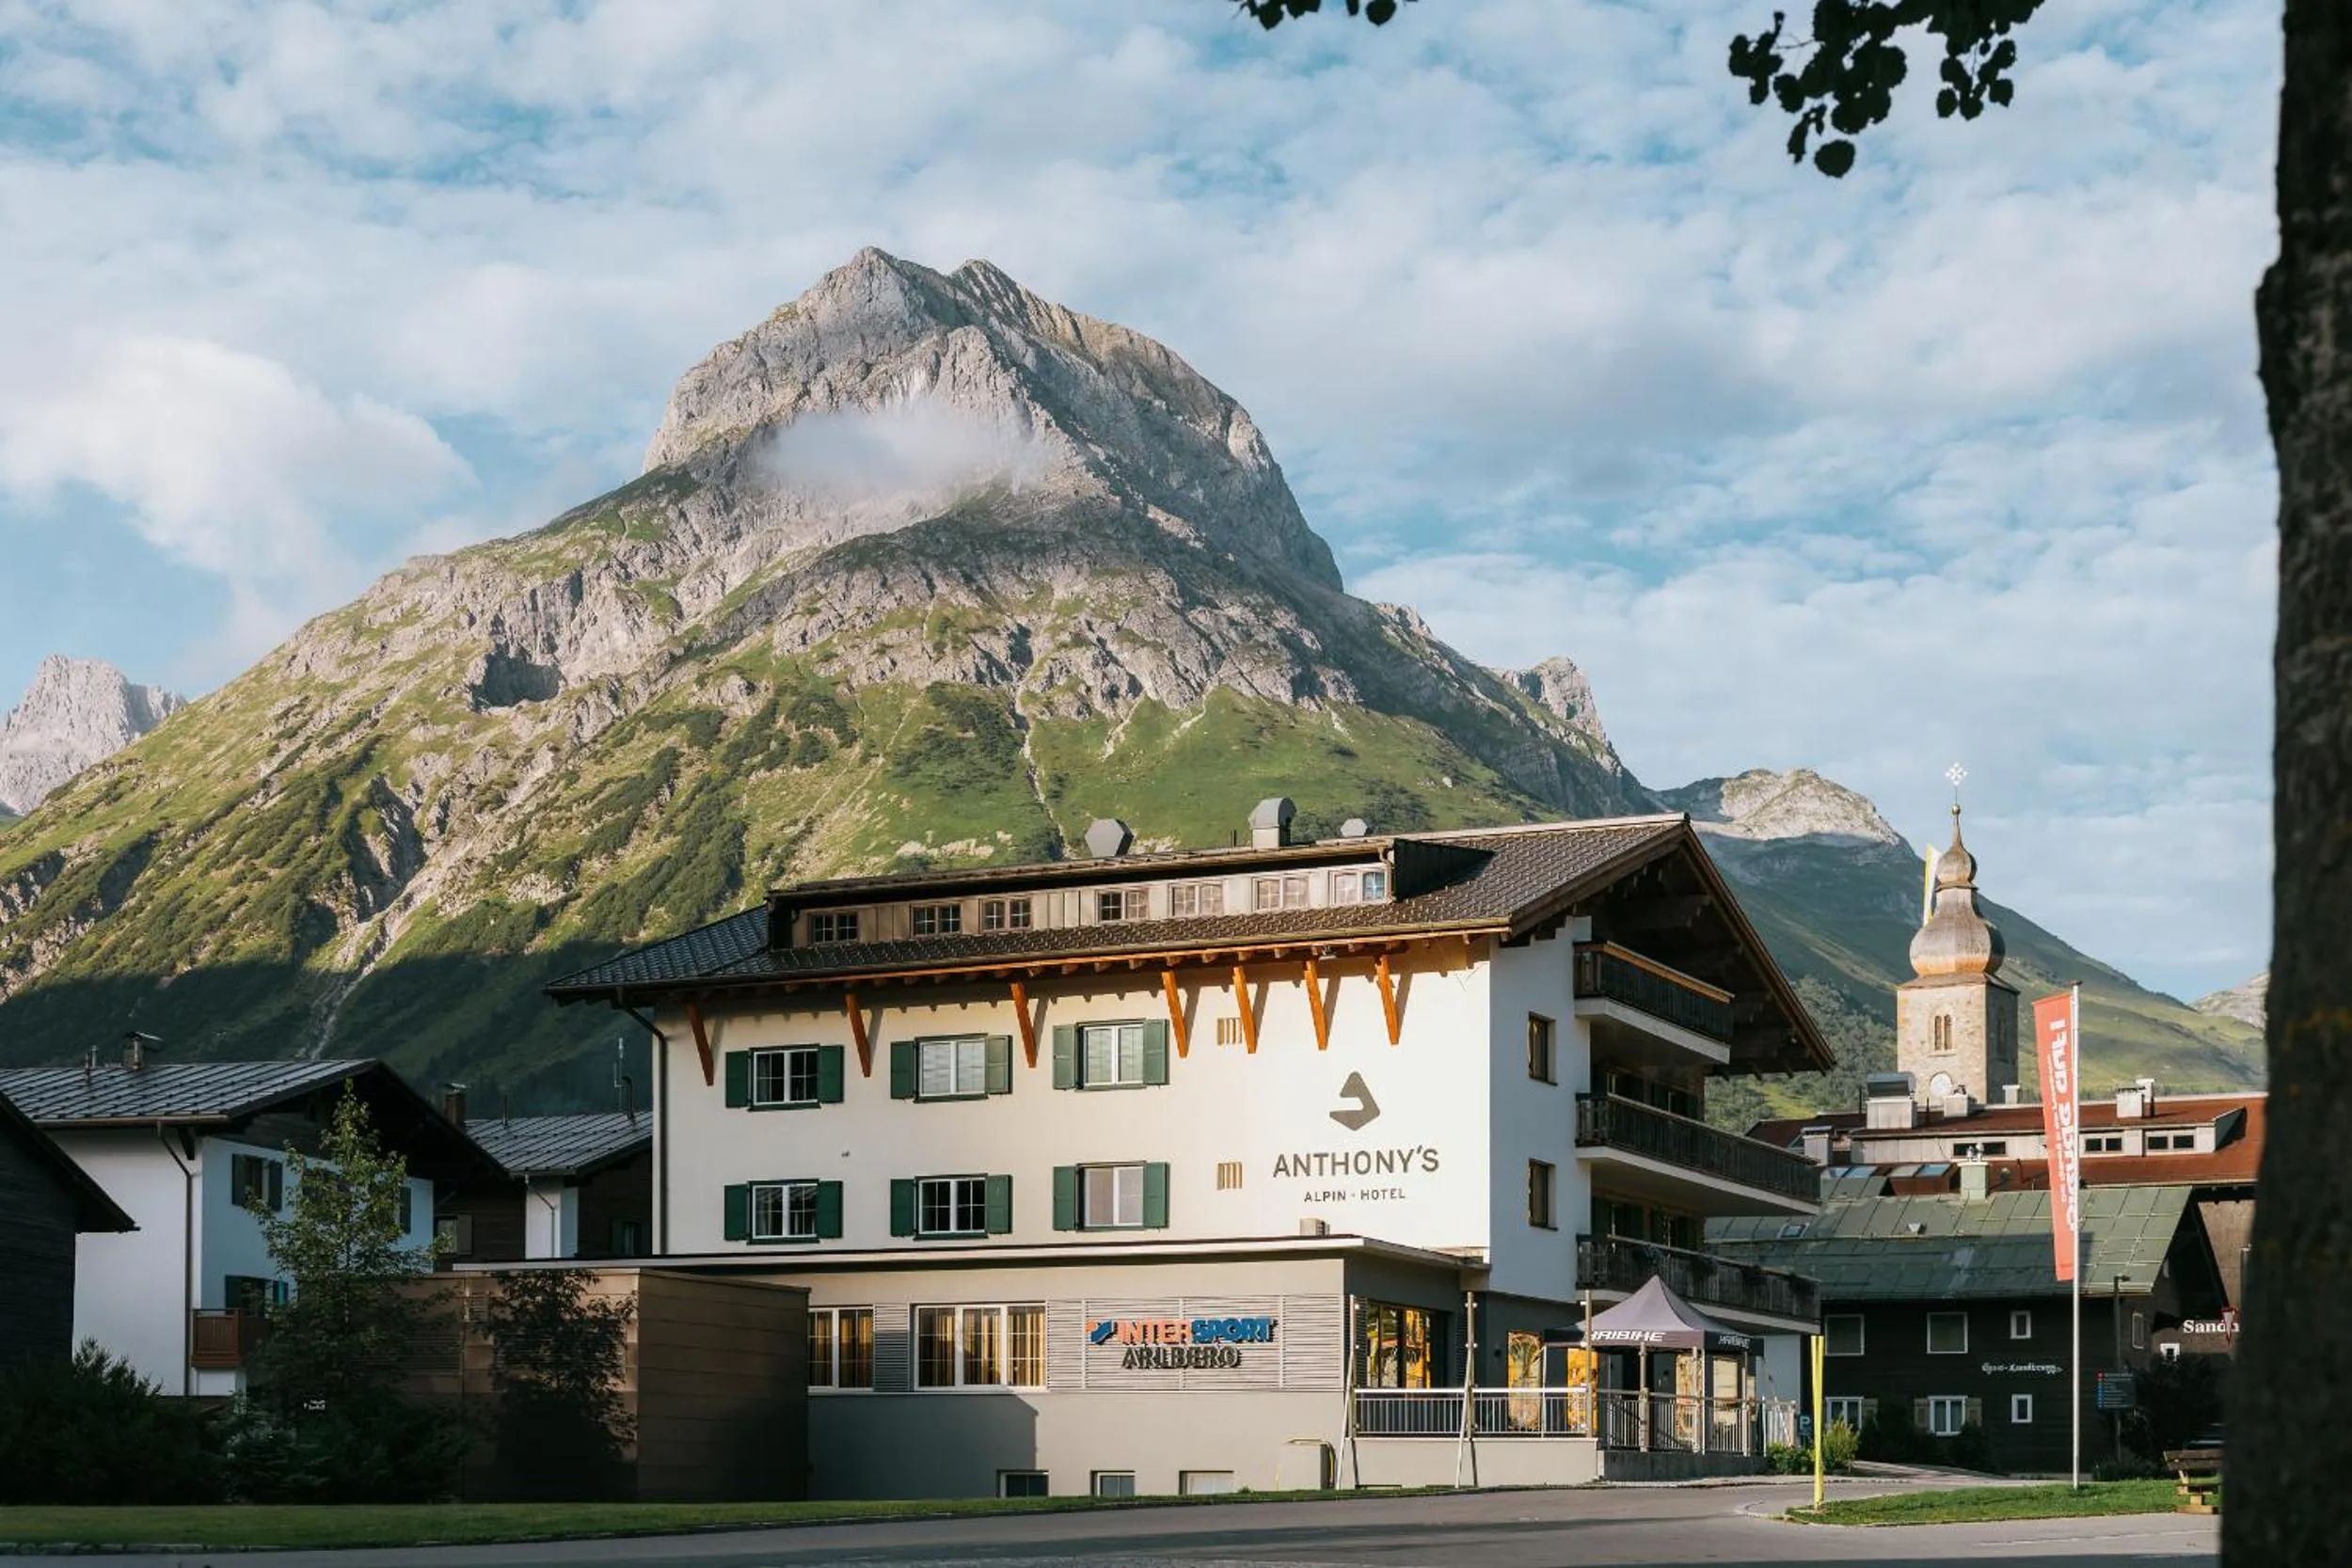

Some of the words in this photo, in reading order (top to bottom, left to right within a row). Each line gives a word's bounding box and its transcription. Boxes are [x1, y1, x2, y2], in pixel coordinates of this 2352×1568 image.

[1272, 1145, 1440, 1178] ANTHONY'S
[1304, 1191, 1346, 1203] ALPIN
[1360, 1188, 1406, 1201] HOTEL
[1116, 1317, 1274, 1344] INTERSPORT
[1799, 1415, 1811, 1431] P
